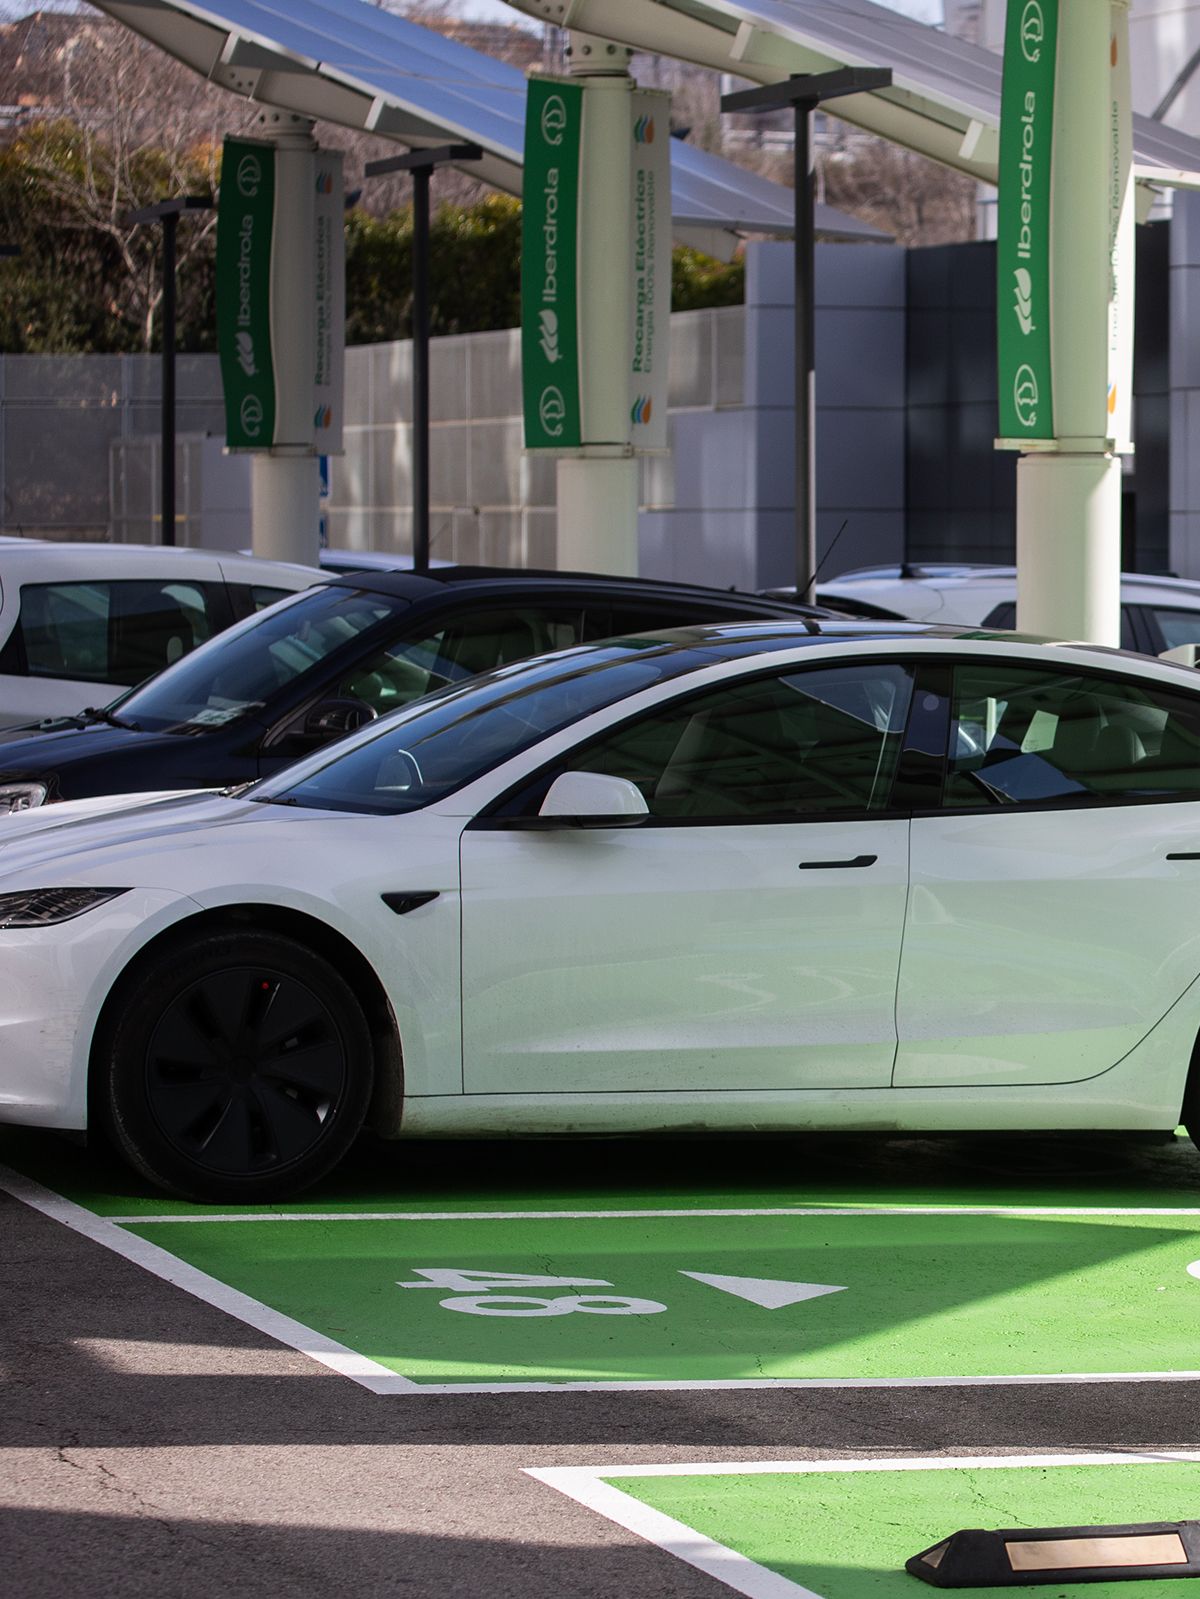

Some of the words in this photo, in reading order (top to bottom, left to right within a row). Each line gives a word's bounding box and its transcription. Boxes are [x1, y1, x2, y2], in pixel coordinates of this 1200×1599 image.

[542, 167, 559, 302] Iberdrola
[1017, 91, 1035, 259] Iberdrola
[237, 214, 253, 326] Iberdrola
[631, 277, 646, 373] Recarga
